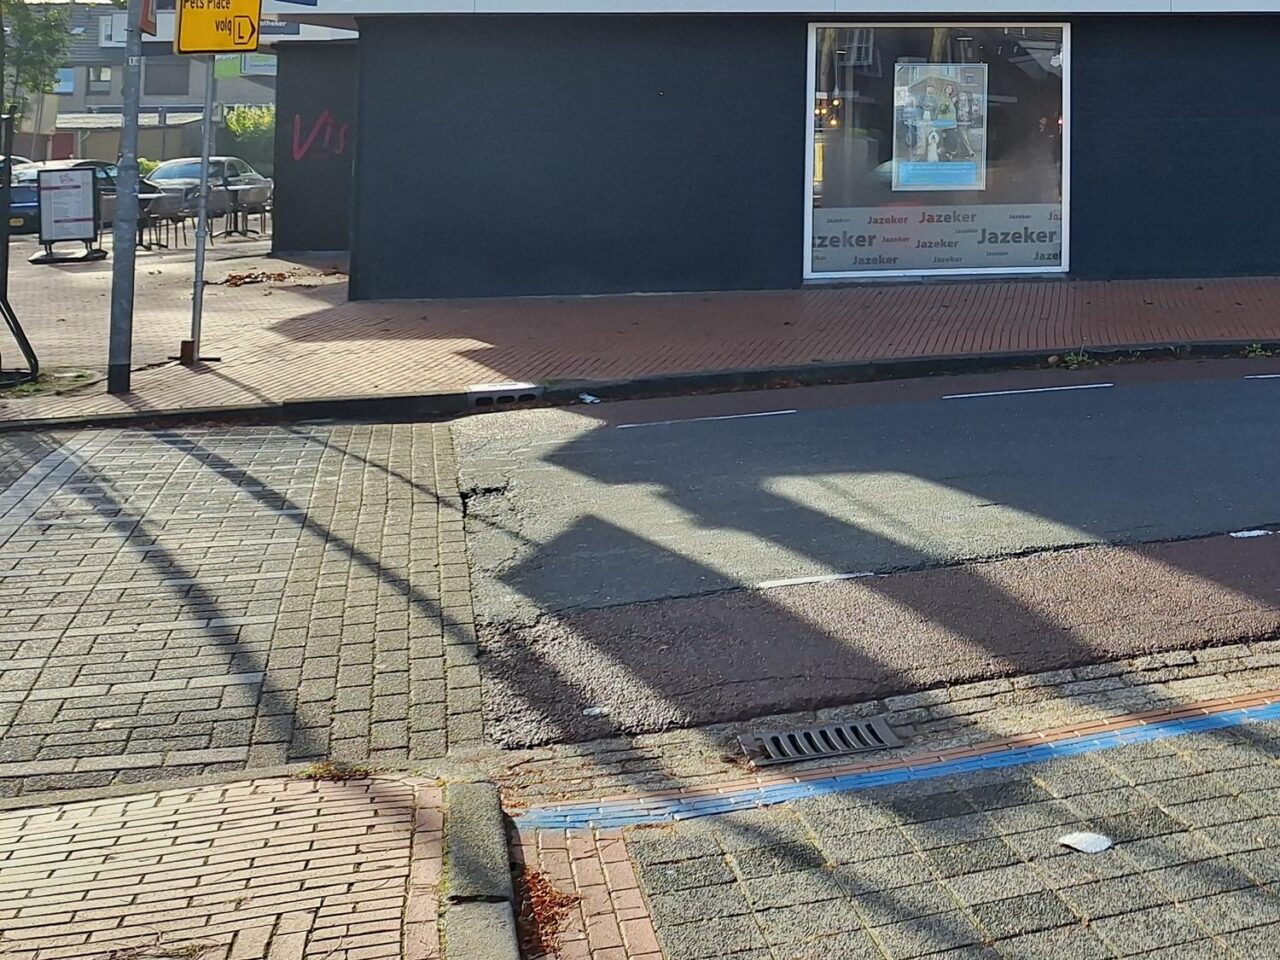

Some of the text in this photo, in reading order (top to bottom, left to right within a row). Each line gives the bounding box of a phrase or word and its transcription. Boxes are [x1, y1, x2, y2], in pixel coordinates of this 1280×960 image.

[215, 17, 245, 39] volg L
[260, 19, 288, 27] otheker
[867, 215, 909, 225] Jazeker
[918, 210, 977, 224] Jazeker
[977, 226, 1057, 245] Jazeker
[915, 238, 959, 249] Jazeker
[852, 254, 899, 265] Jazeker
